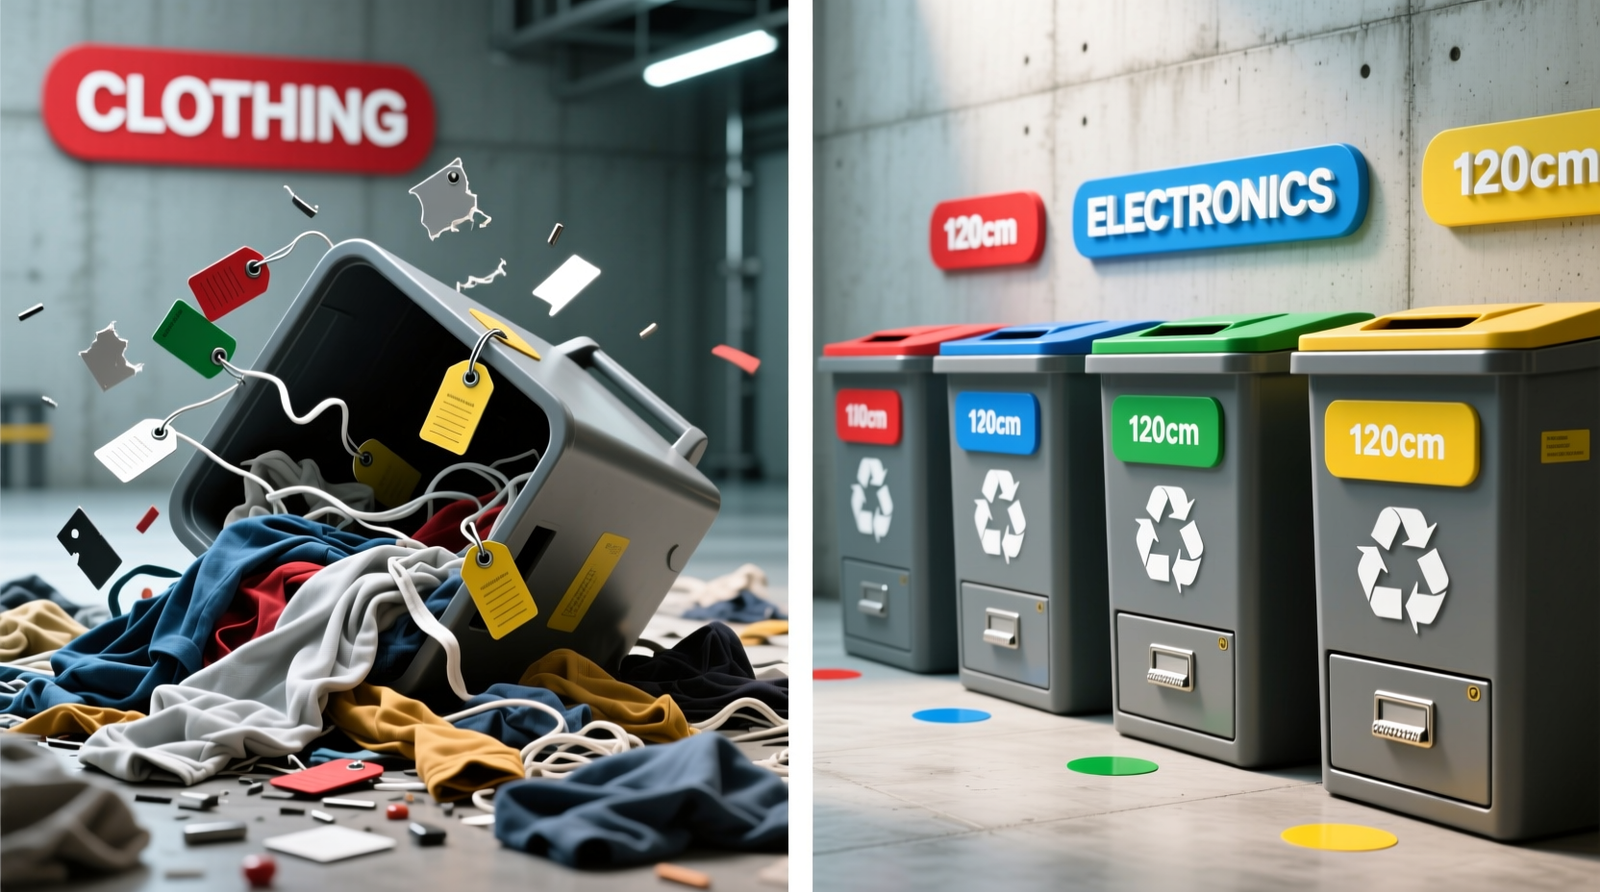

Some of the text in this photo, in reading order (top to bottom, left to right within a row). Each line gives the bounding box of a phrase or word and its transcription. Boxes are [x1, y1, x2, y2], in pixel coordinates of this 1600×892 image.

[76, 70, 407, 147] CLOTHING
[1453, 146, 1599, 196] 120cm
[1087, 168, 1335, 238] ELECTRONICS
[943, 213, 1018, 251] 120cm
[968, 409, 1021, 436] 120cm
[1129, 414, 1199, 446] 120cm
[1349, 423, 1445, 460] 120cm
